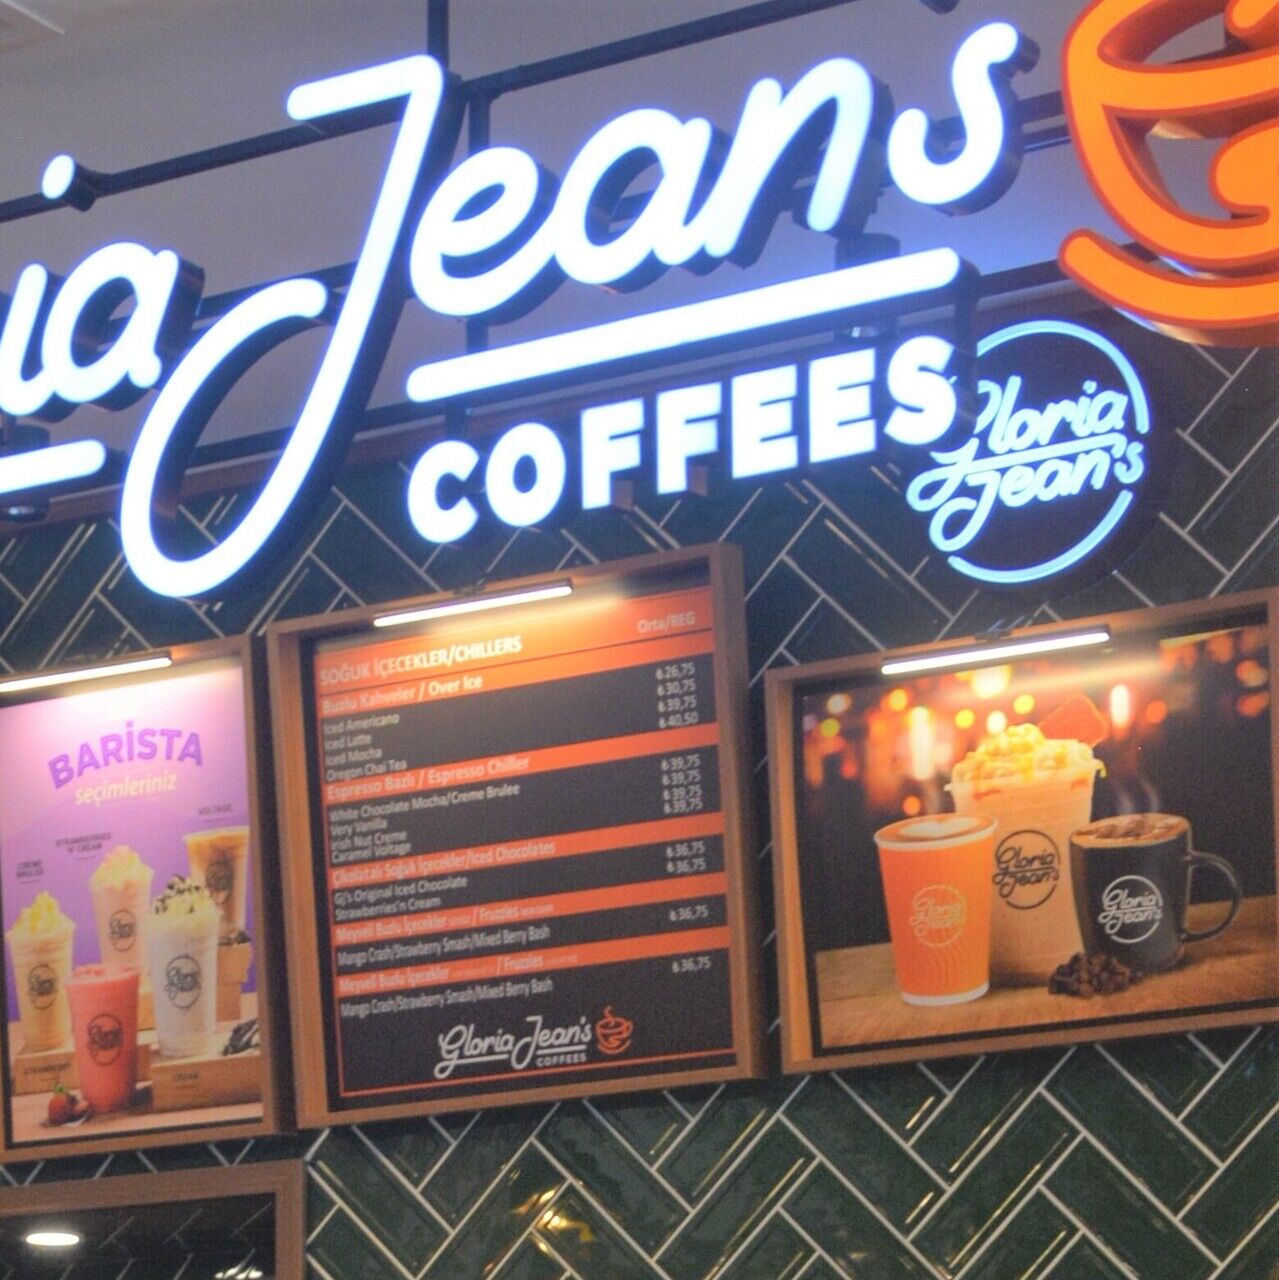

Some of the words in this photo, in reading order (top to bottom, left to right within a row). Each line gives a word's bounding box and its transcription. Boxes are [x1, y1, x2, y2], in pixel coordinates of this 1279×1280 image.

[406, 335, 956, 545] COFFEES
[638, 612, 695, 632] Orta/REG
[320, 659, 370, 683] SOĞUK
[375, 635, 522, 676] İÇECEKLER/CHILLERS
[429, 678, 460, 695] Over
[464, 674, 483, 689] Ice
[347, 712, 400, 730] Americano
[49, 720, 203, 789] BARİSTA
[389, 758, 406, 770] Tea
[328, 778, 381, 799] Espresso
[428, 762, 485, 784] Espresso
[488, 754, 529, 774] Chiller
[362, 800, 409, 817] Chocolate
[992, 846, 1056, 884] Gloria
[419, 875, 468, 892] Chocolate
[1098, 889, 1157, 923] Gloria
[433, 1024, 515, 1079] Gloria
[511, 1015, 592, 1070] Jean's
[536, 1053, 587, 1067] COFFEES
